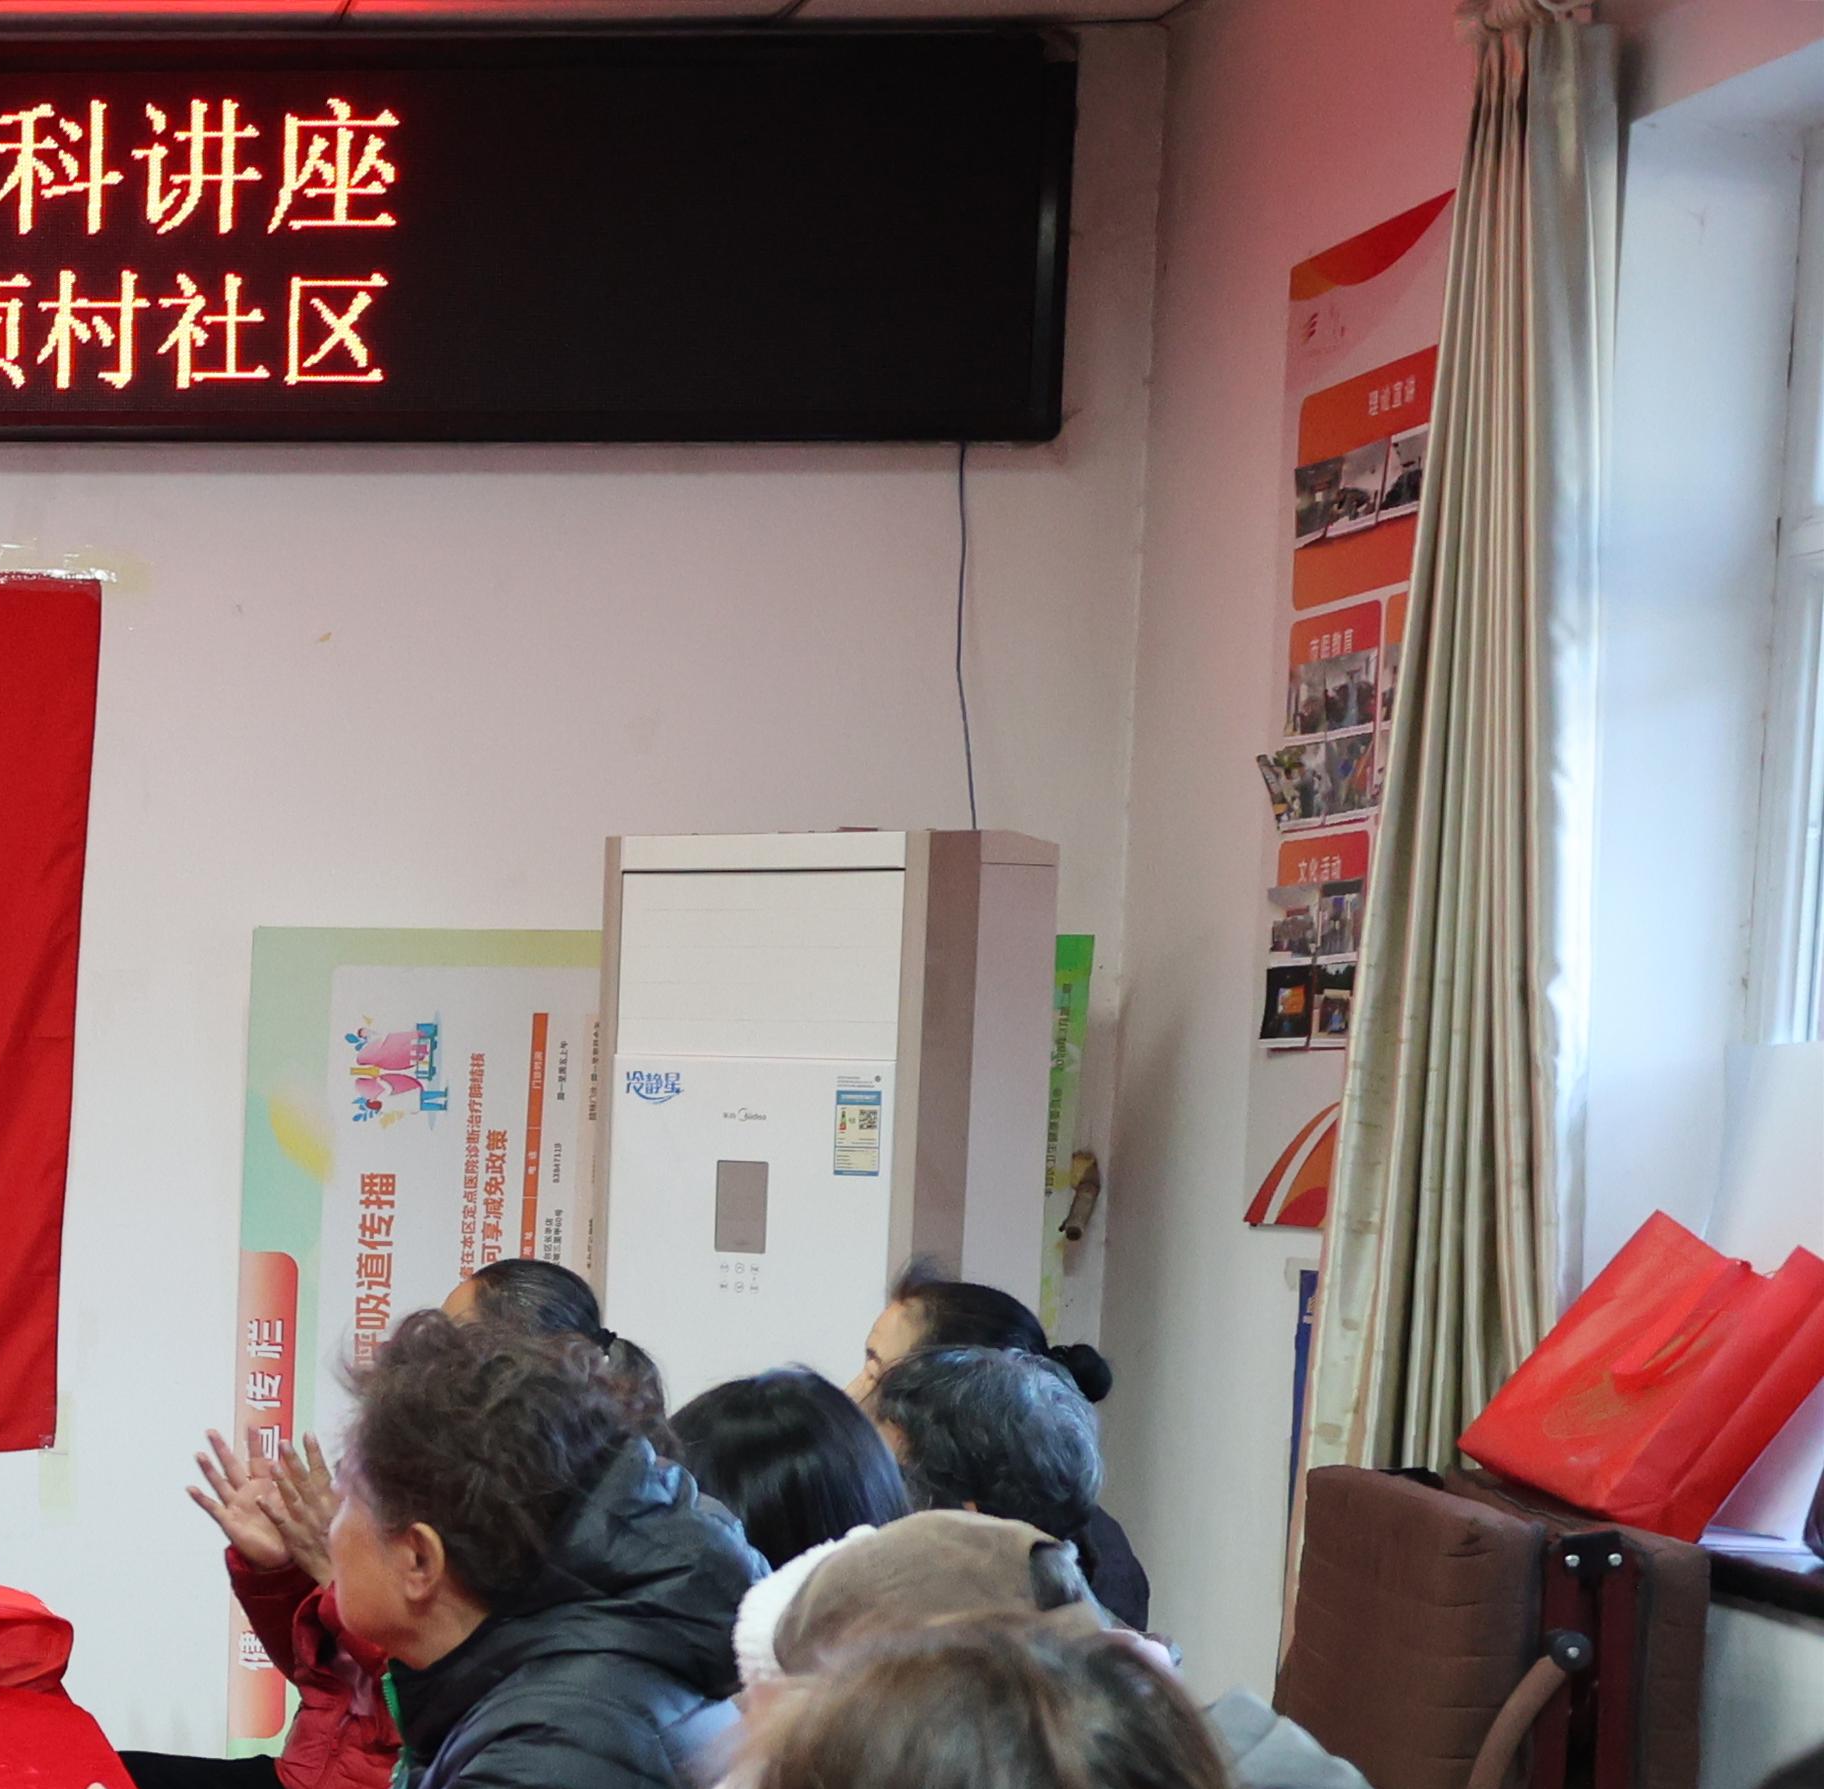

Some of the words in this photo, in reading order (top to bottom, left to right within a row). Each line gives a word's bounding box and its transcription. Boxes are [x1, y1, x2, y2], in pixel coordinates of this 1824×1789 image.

[481, 1129, 508, 1266] 可享减免政策
